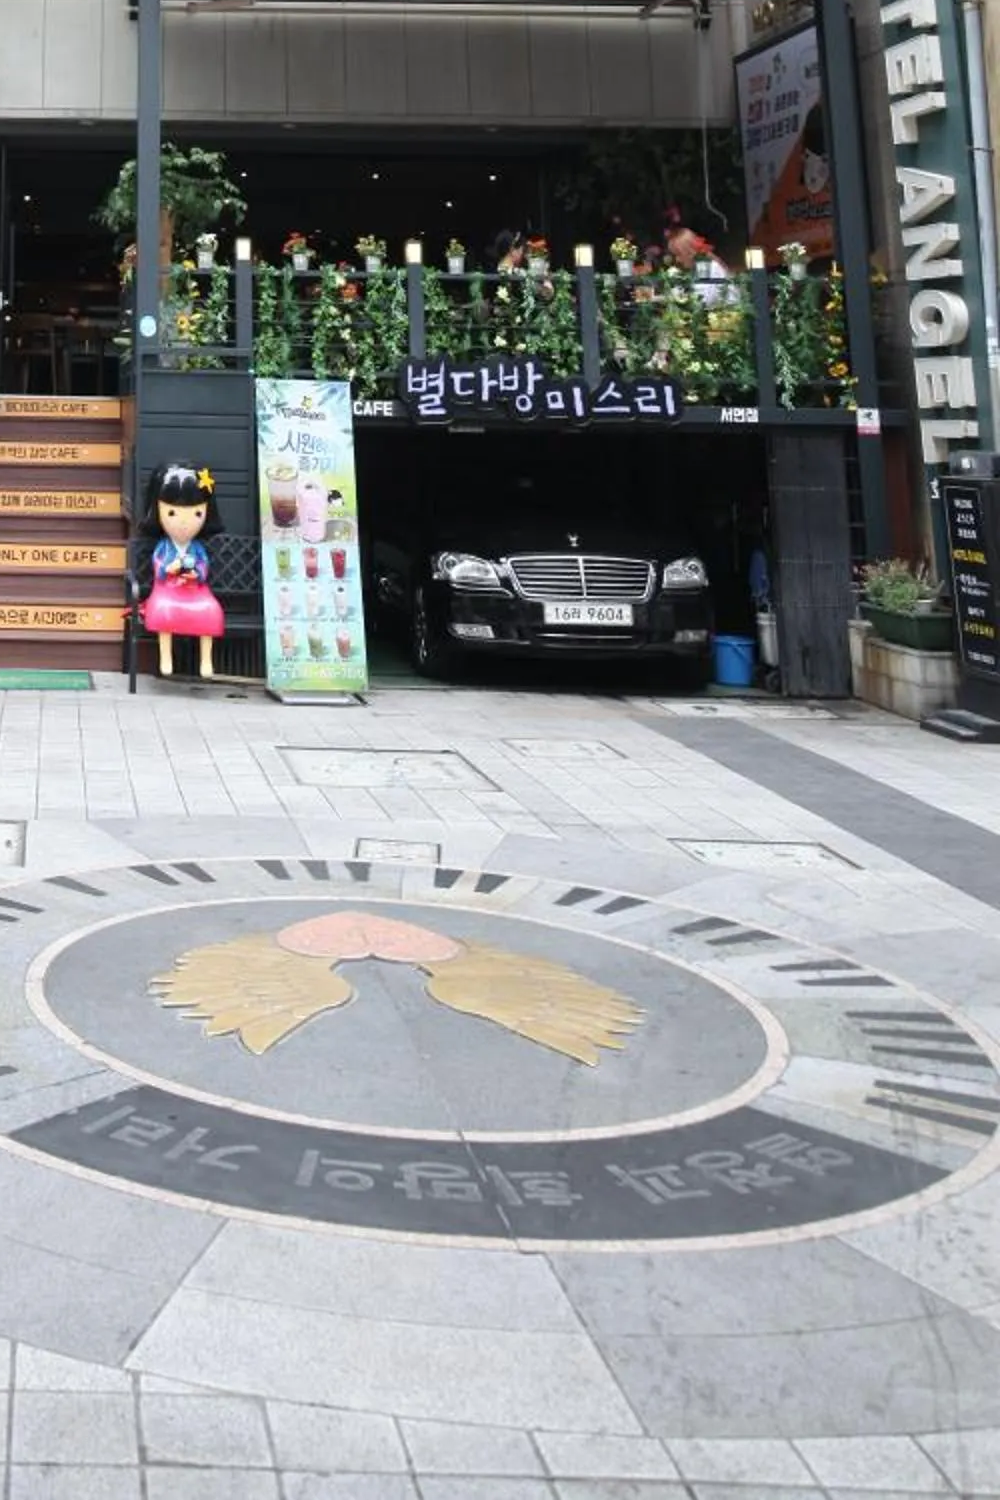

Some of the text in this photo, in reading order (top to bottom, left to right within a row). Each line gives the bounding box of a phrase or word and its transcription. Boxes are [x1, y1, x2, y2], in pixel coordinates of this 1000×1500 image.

[896, 164, 980, 465] ANGEL
[407, 360, 676, 417] 별다방미스리
[353, 401, 393, 417] CAFE
[50, 446, 80, 459] CAFE
[31, 549, 59, 563] ONE
[63, 551, 98, 564] CAFE
[587, 607, 624, 621] 9604
[78, 1103, 857, 1208] 열정과 희망의 거리
